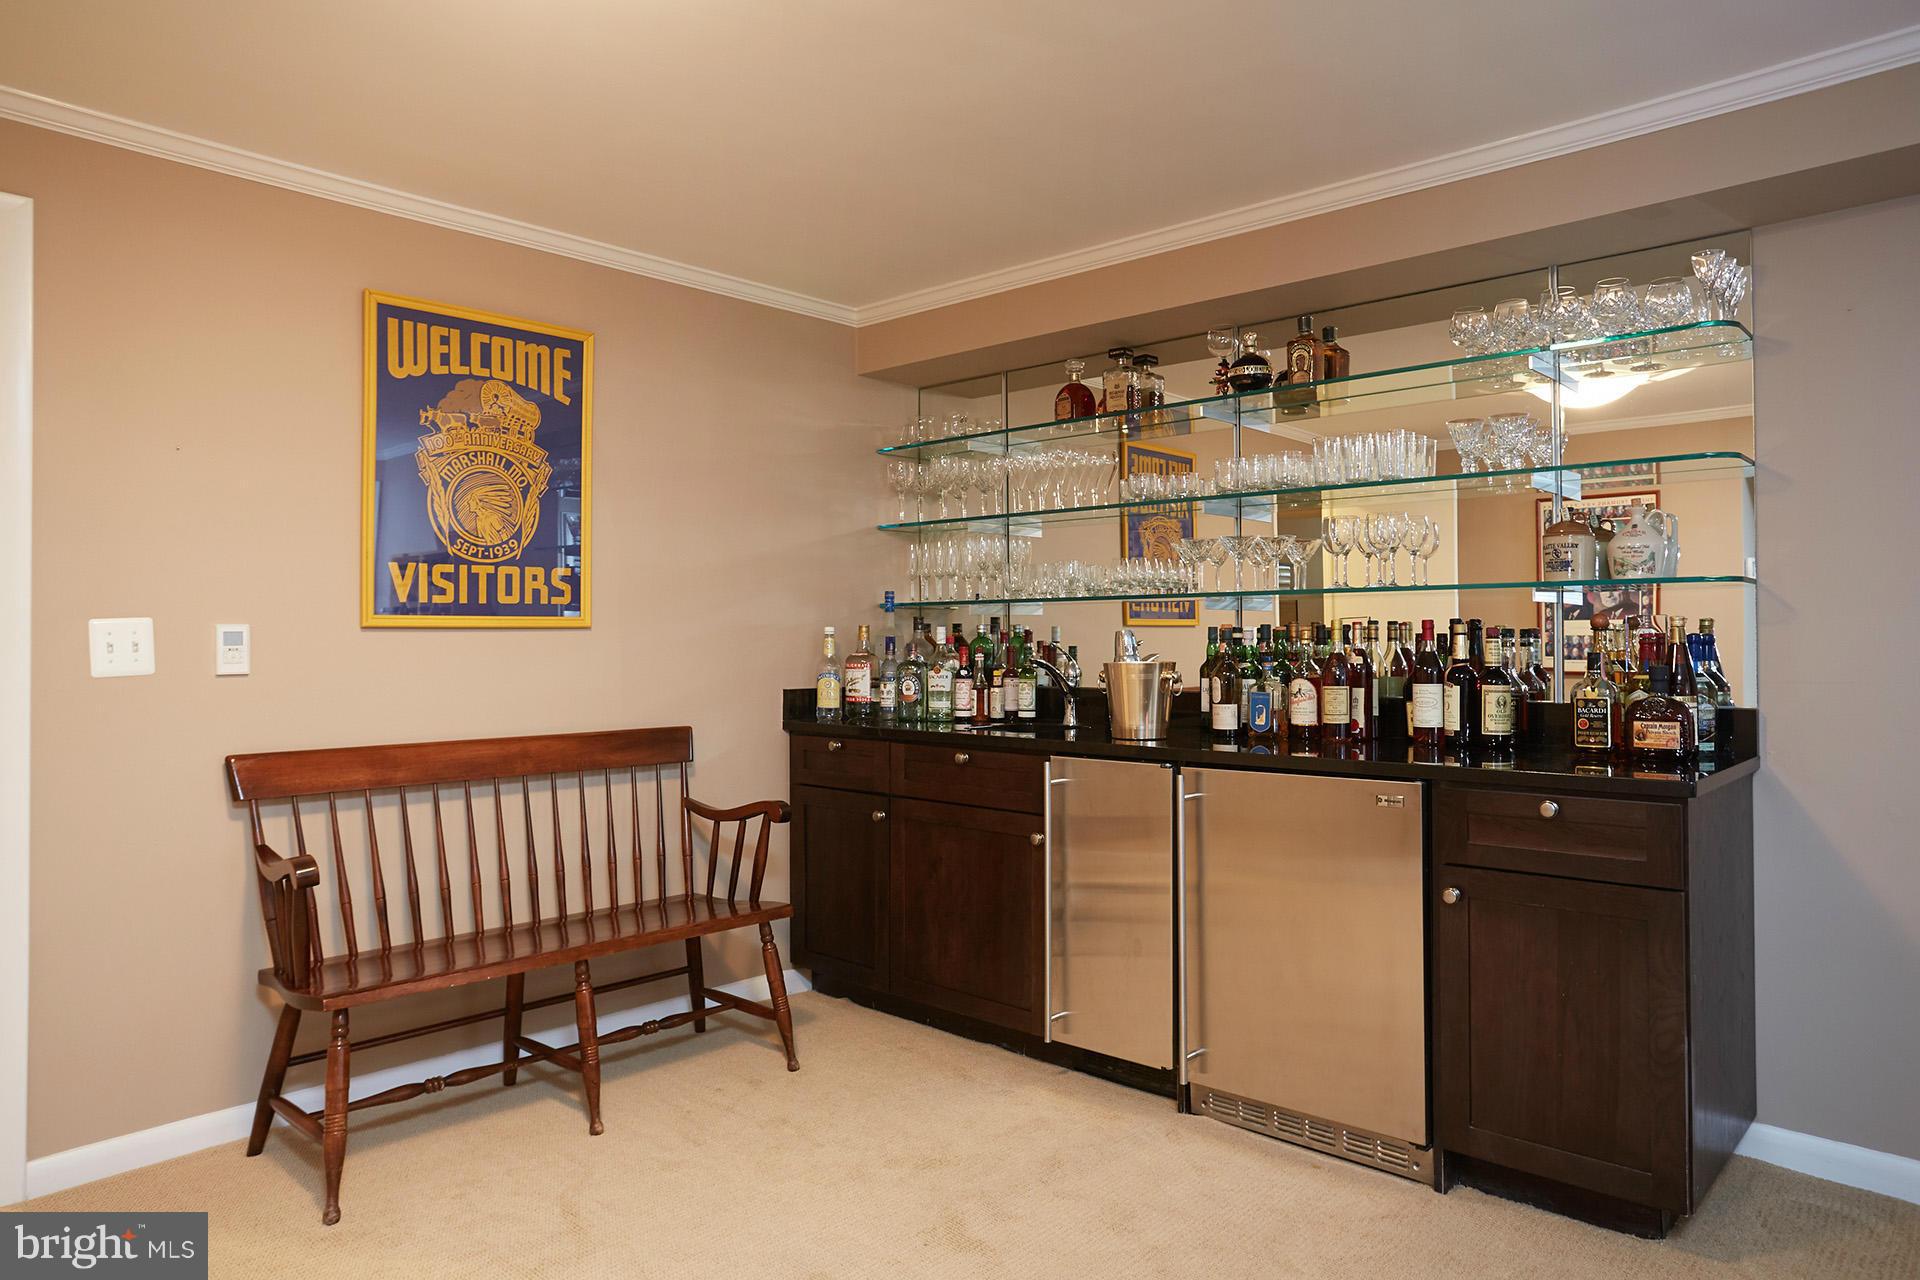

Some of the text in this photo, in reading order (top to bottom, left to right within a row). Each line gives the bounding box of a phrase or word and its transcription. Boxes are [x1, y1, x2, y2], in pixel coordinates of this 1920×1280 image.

[387, 317, 571, 406] WELCOME
[464, 431, 542, 462] ANNIVERSARY
[453, 538, 519, 559] SEPT-1939
[387, 561, 572, 605] VISITORS
